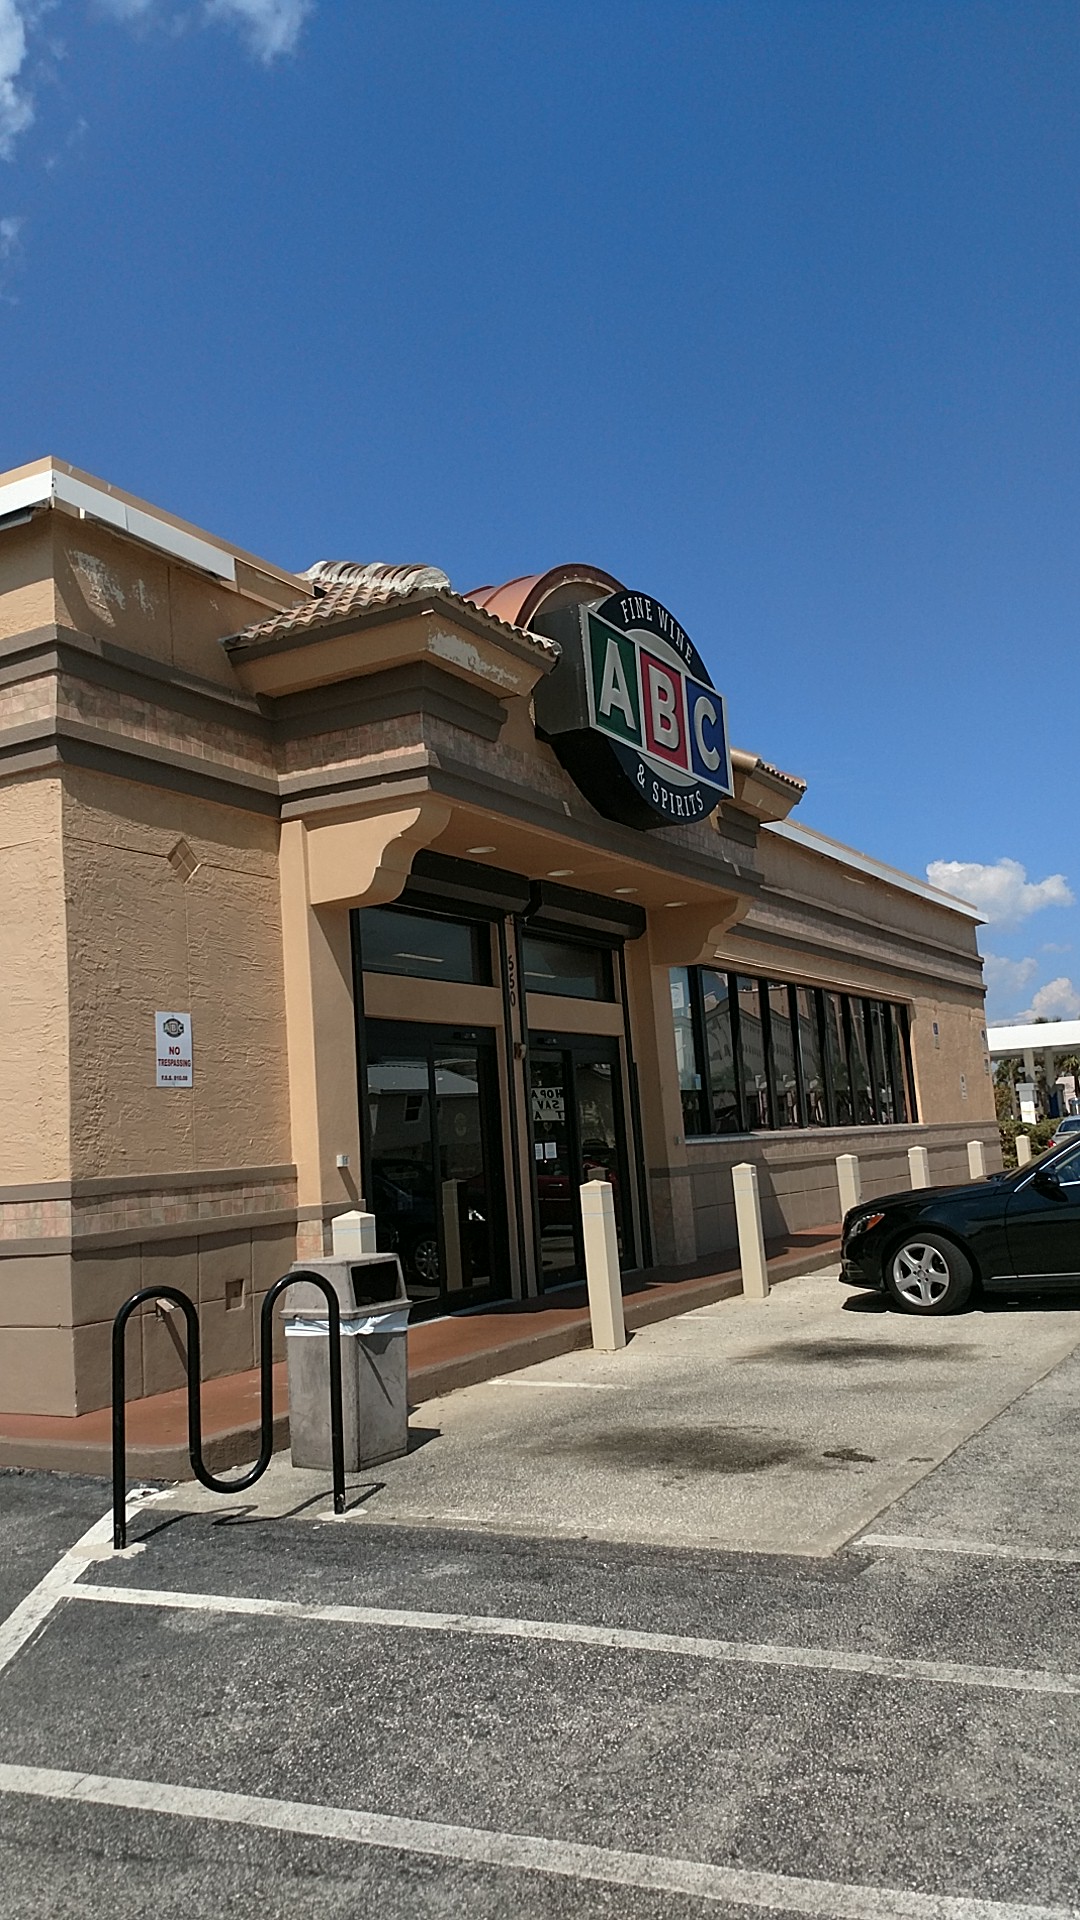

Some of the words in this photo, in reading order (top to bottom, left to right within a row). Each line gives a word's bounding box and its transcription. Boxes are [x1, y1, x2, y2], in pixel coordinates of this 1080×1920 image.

[620, 597, 652, 623] FINE
[657, 606, 692, 664] WINE
[600, 638, 721, 771] ABC
[636, 764, 645, 788] &
[652, 781, 704, 817] SPIRITS
[508, 954, 516, 1007] 550
[158, 1059, 191, 1067] TRESPASSING
[169, 1046, 180, 1055] NO
